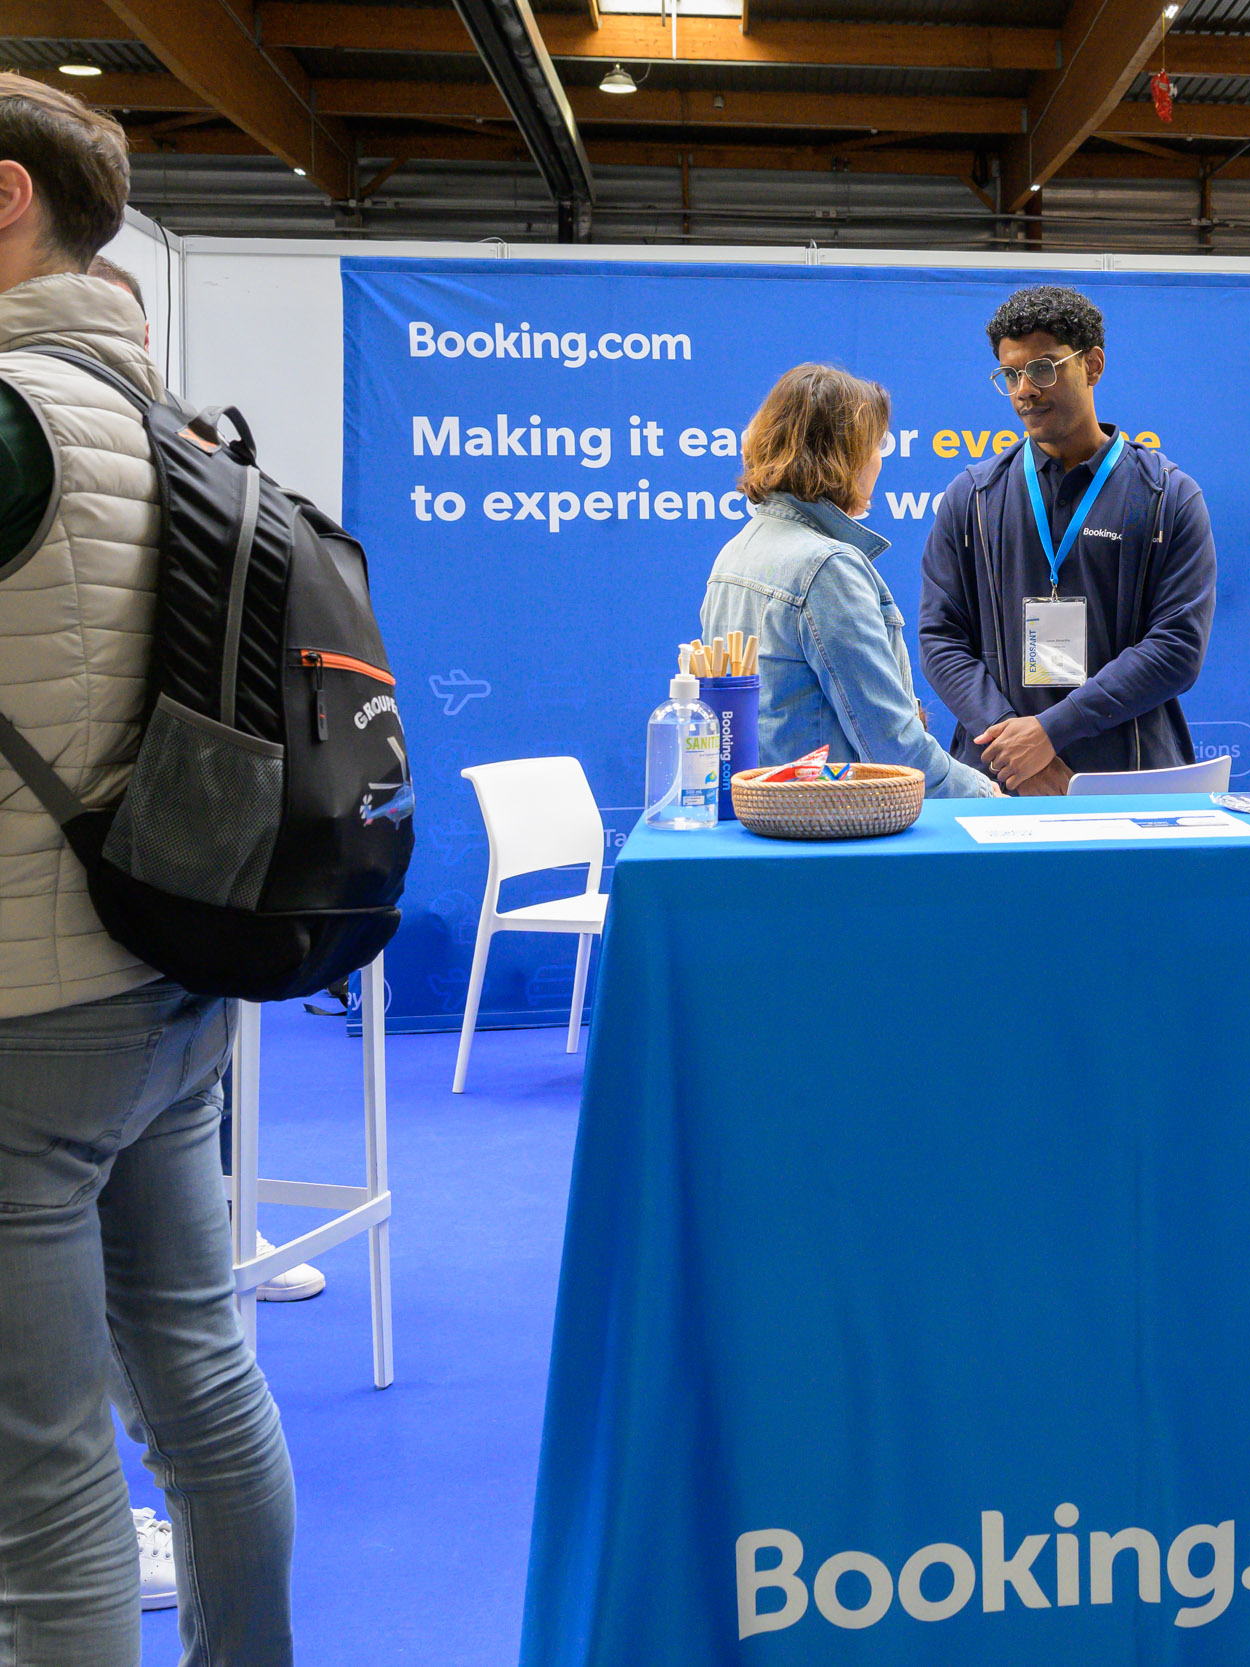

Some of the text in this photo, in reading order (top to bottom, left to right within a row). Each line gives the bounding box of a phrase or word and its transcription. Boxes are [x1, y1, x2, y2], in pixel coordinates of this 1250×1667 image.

[409, 321, 692, 369] Booking.com
[412, 413, 612, 469] Making
[629, 414, 664, 457] it
[410, 485, 466, 522] to
[1029, 629, 1037, 673] EXPOSANT
[720, 711, 733, 791] Booking.com
